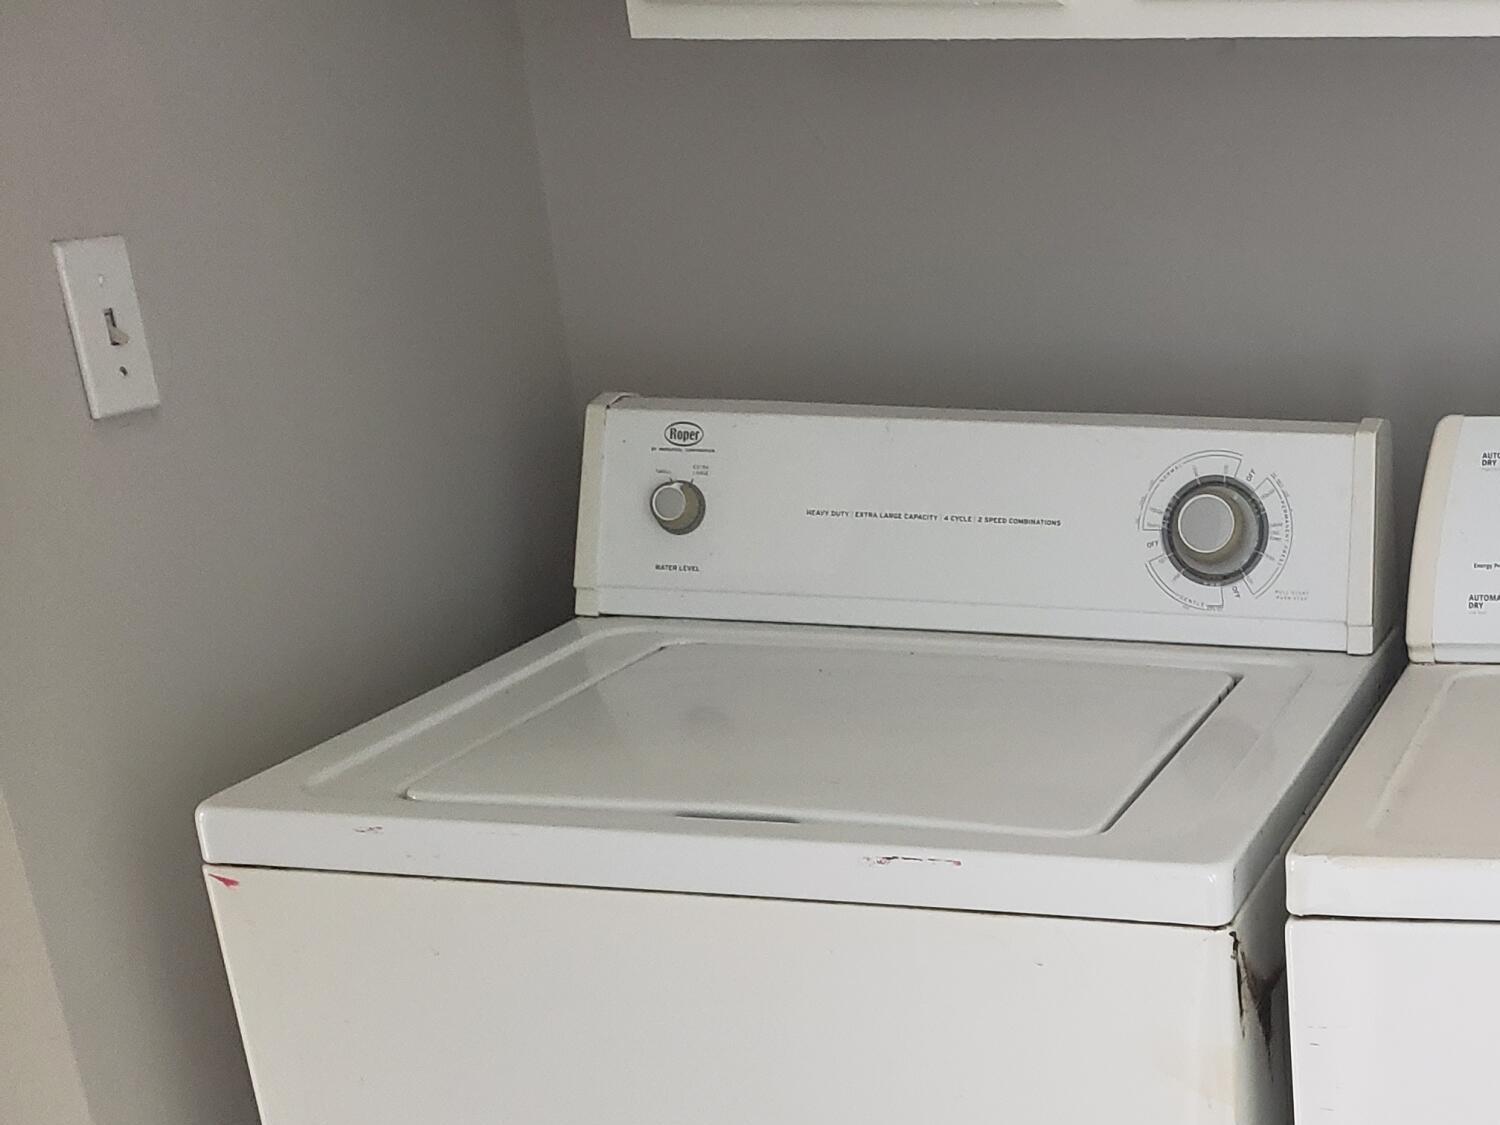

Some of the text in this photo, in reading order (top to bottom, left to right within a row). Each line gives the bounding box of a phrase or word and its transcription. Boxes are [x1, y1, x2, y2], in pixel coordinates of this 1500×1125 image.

[669, 427, 701, 442] Roper
[806, 509, 829, 517] HEAVY
[904, 512, 938, 521] CAPACITY
[1008, 518, 1062, 527] COMBINATIONS
[679, 564, 699, 572] LEVEL
